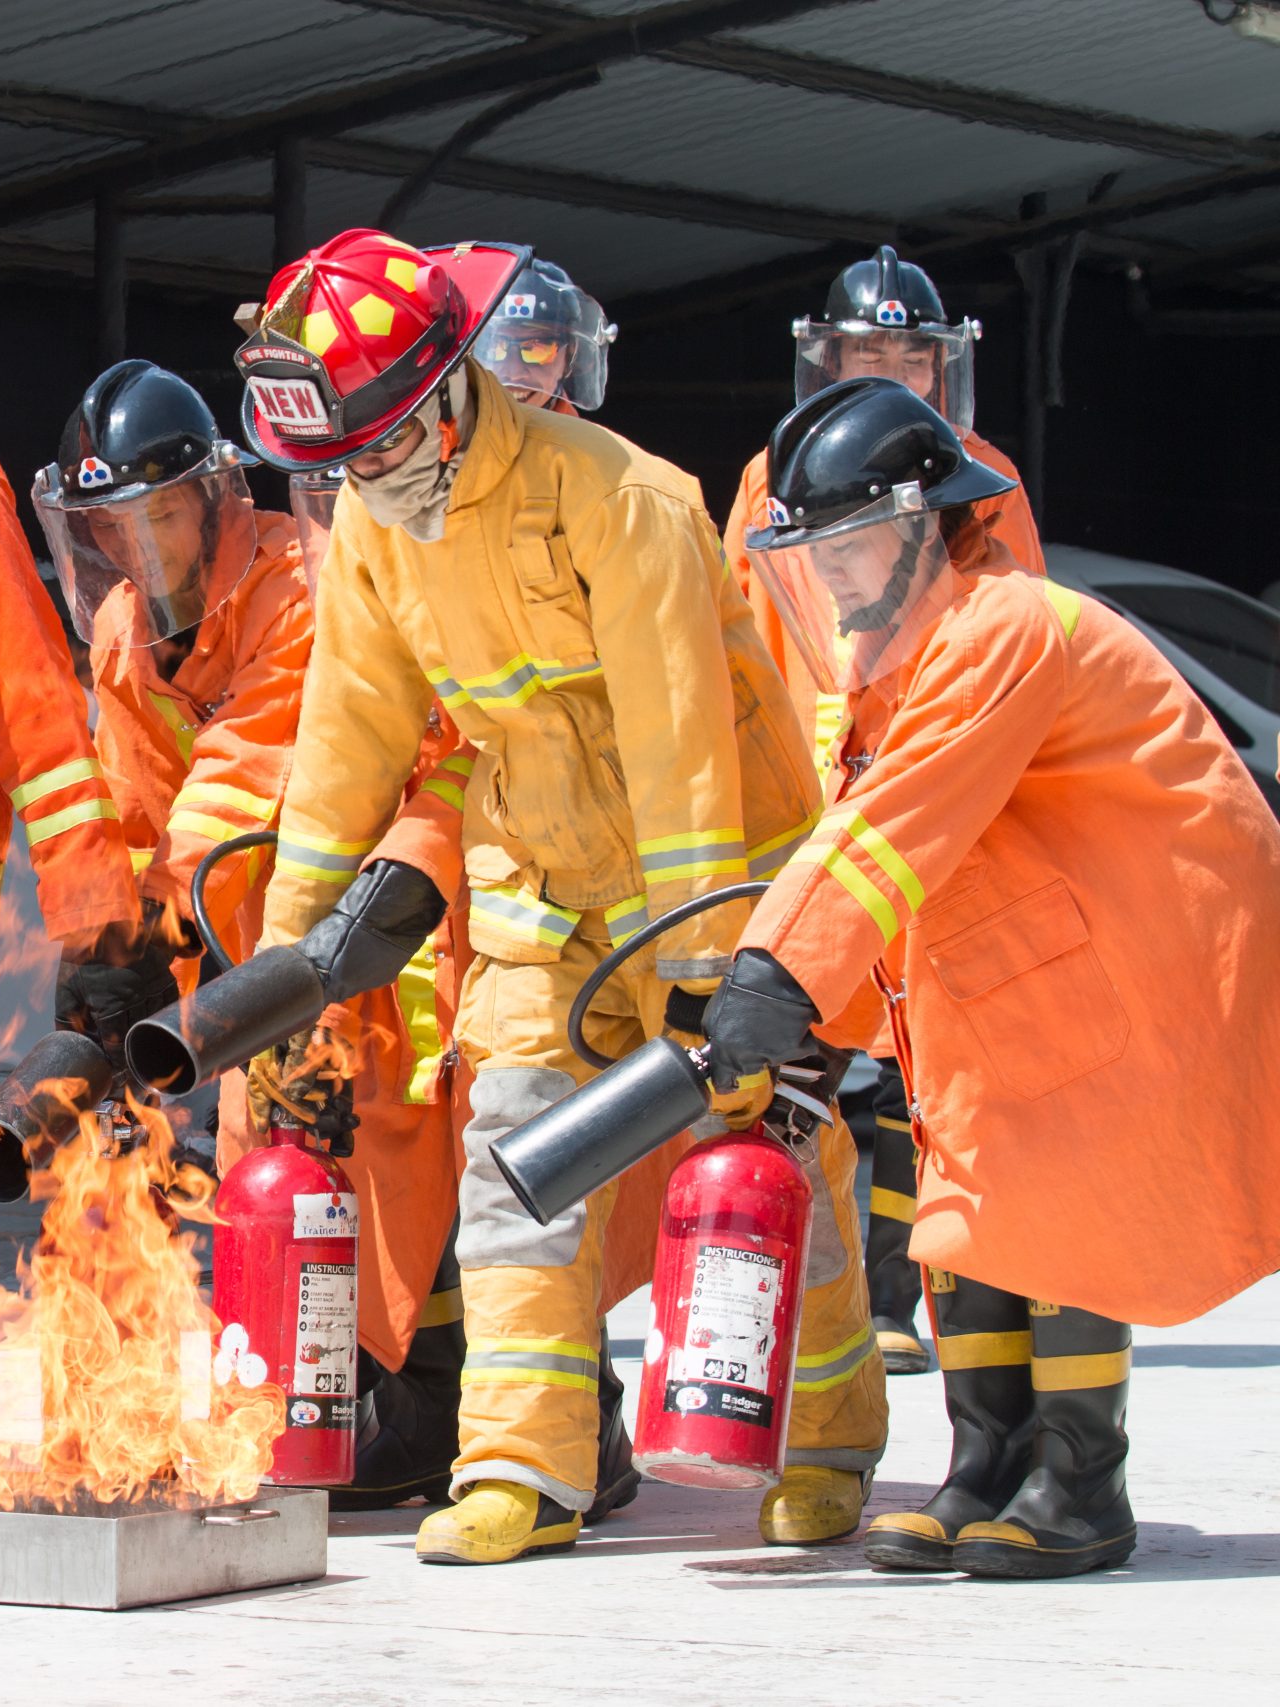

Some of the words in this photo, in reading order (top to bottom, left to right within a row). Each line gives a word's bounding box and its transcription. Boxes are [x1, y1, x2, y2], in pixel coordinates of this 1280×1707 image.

[264, 347, 305, 364] FIGHTER
[255, 385, 317, 419] NEW
[281, 424, 330, 435] TRAINING
[303, 1225, 337, 1235] Trainer
[704, 1246, 776, 1267] INSTRUCTIONS
[721, 1393, 763, 1410] Badger
